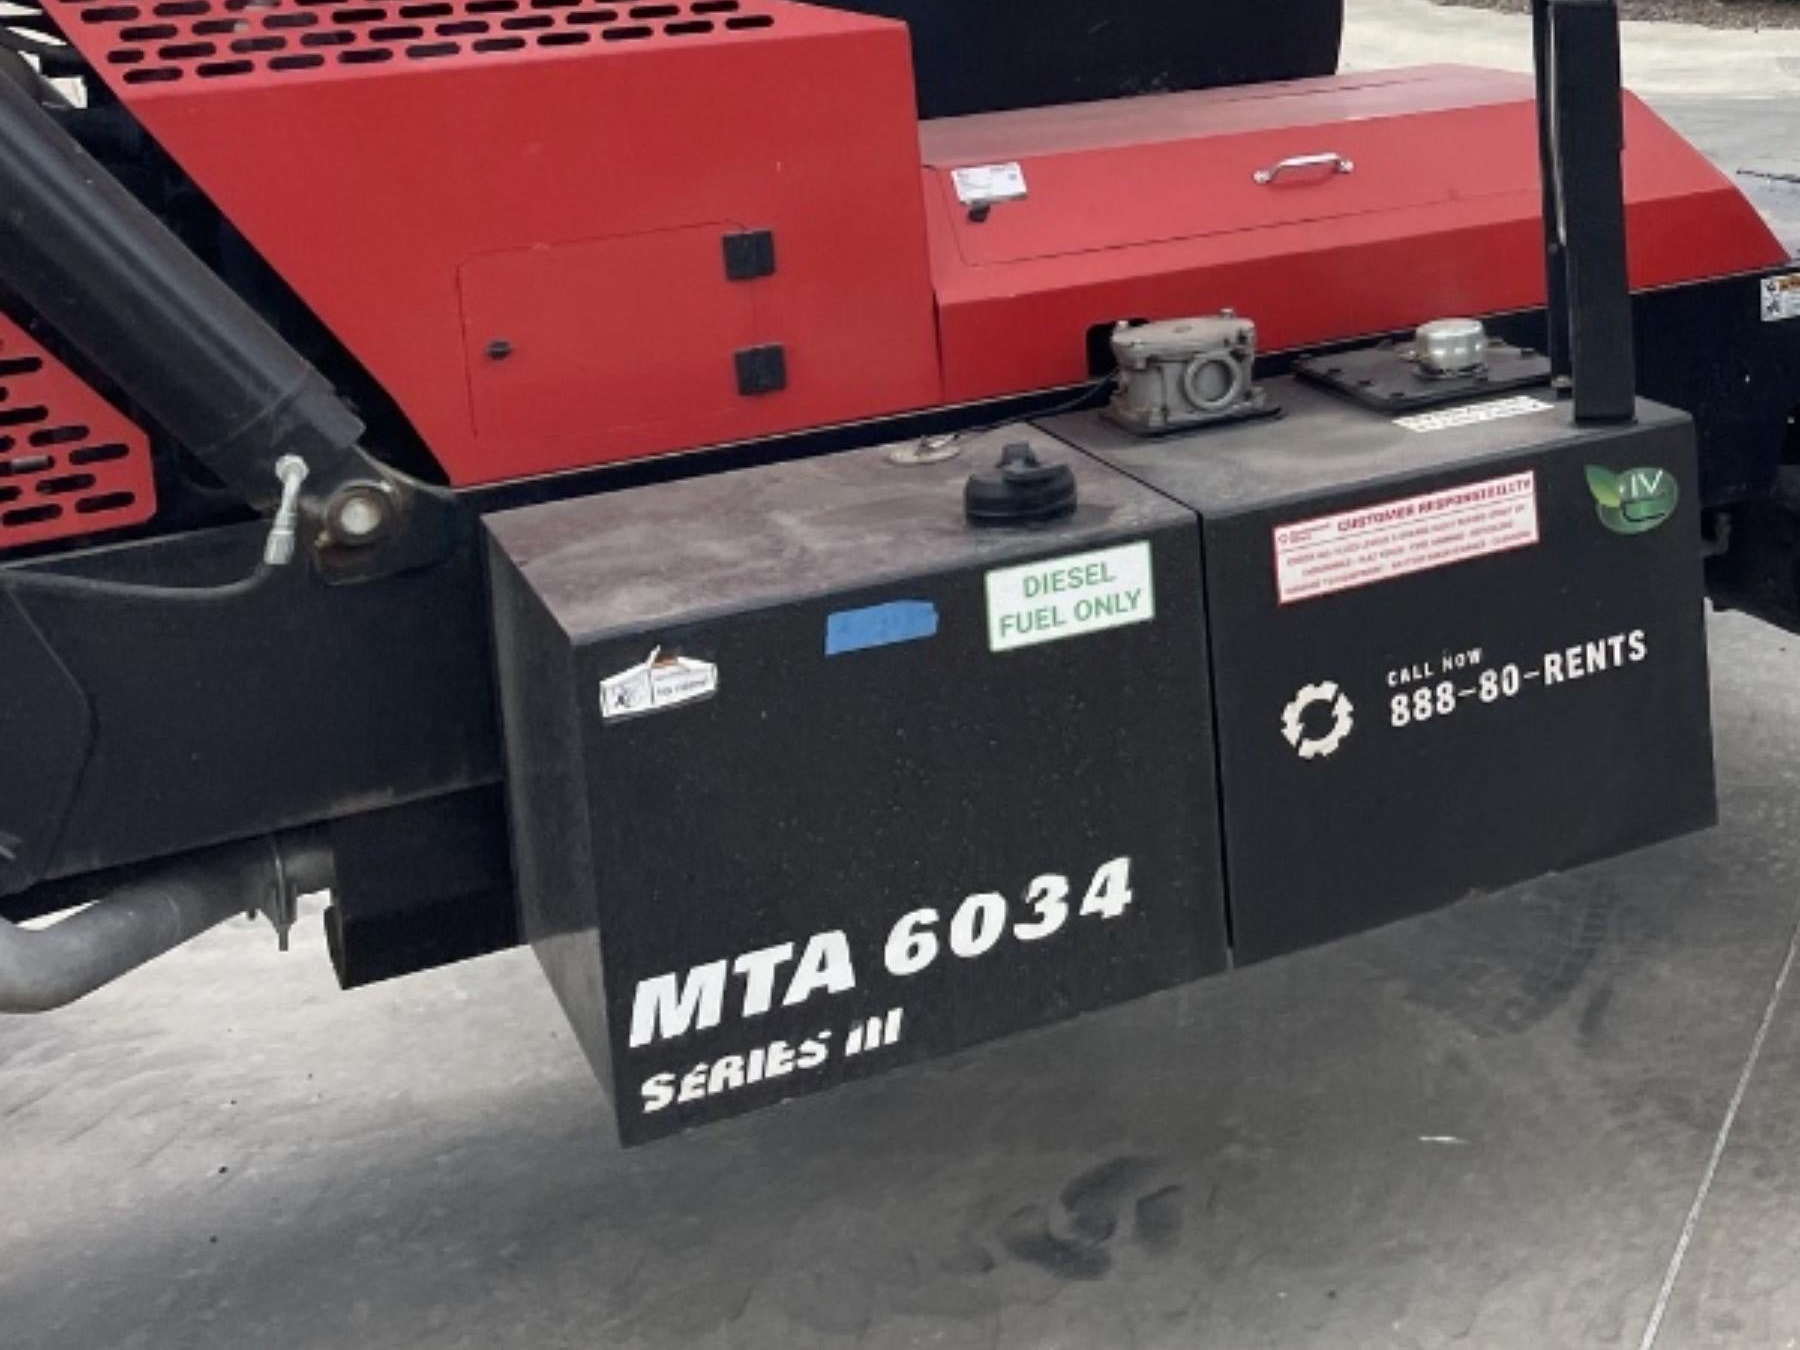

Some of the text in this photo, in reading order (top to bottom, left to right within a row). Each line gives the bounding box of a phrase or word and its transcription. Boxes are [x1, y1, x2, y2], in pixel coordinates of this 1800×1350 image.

[1000, 588, 1142, 638] FUEL ONLY
[1023, 561, 1116, 598] DIESEL
[1387, 648, 1483, 687] CALL NOW
[1390, 629, 1647, 727] 888-80-RENTS
[629, 856, 1133, 1049] MTA 6034
[641, 1029, 829, 1114] SERIES
